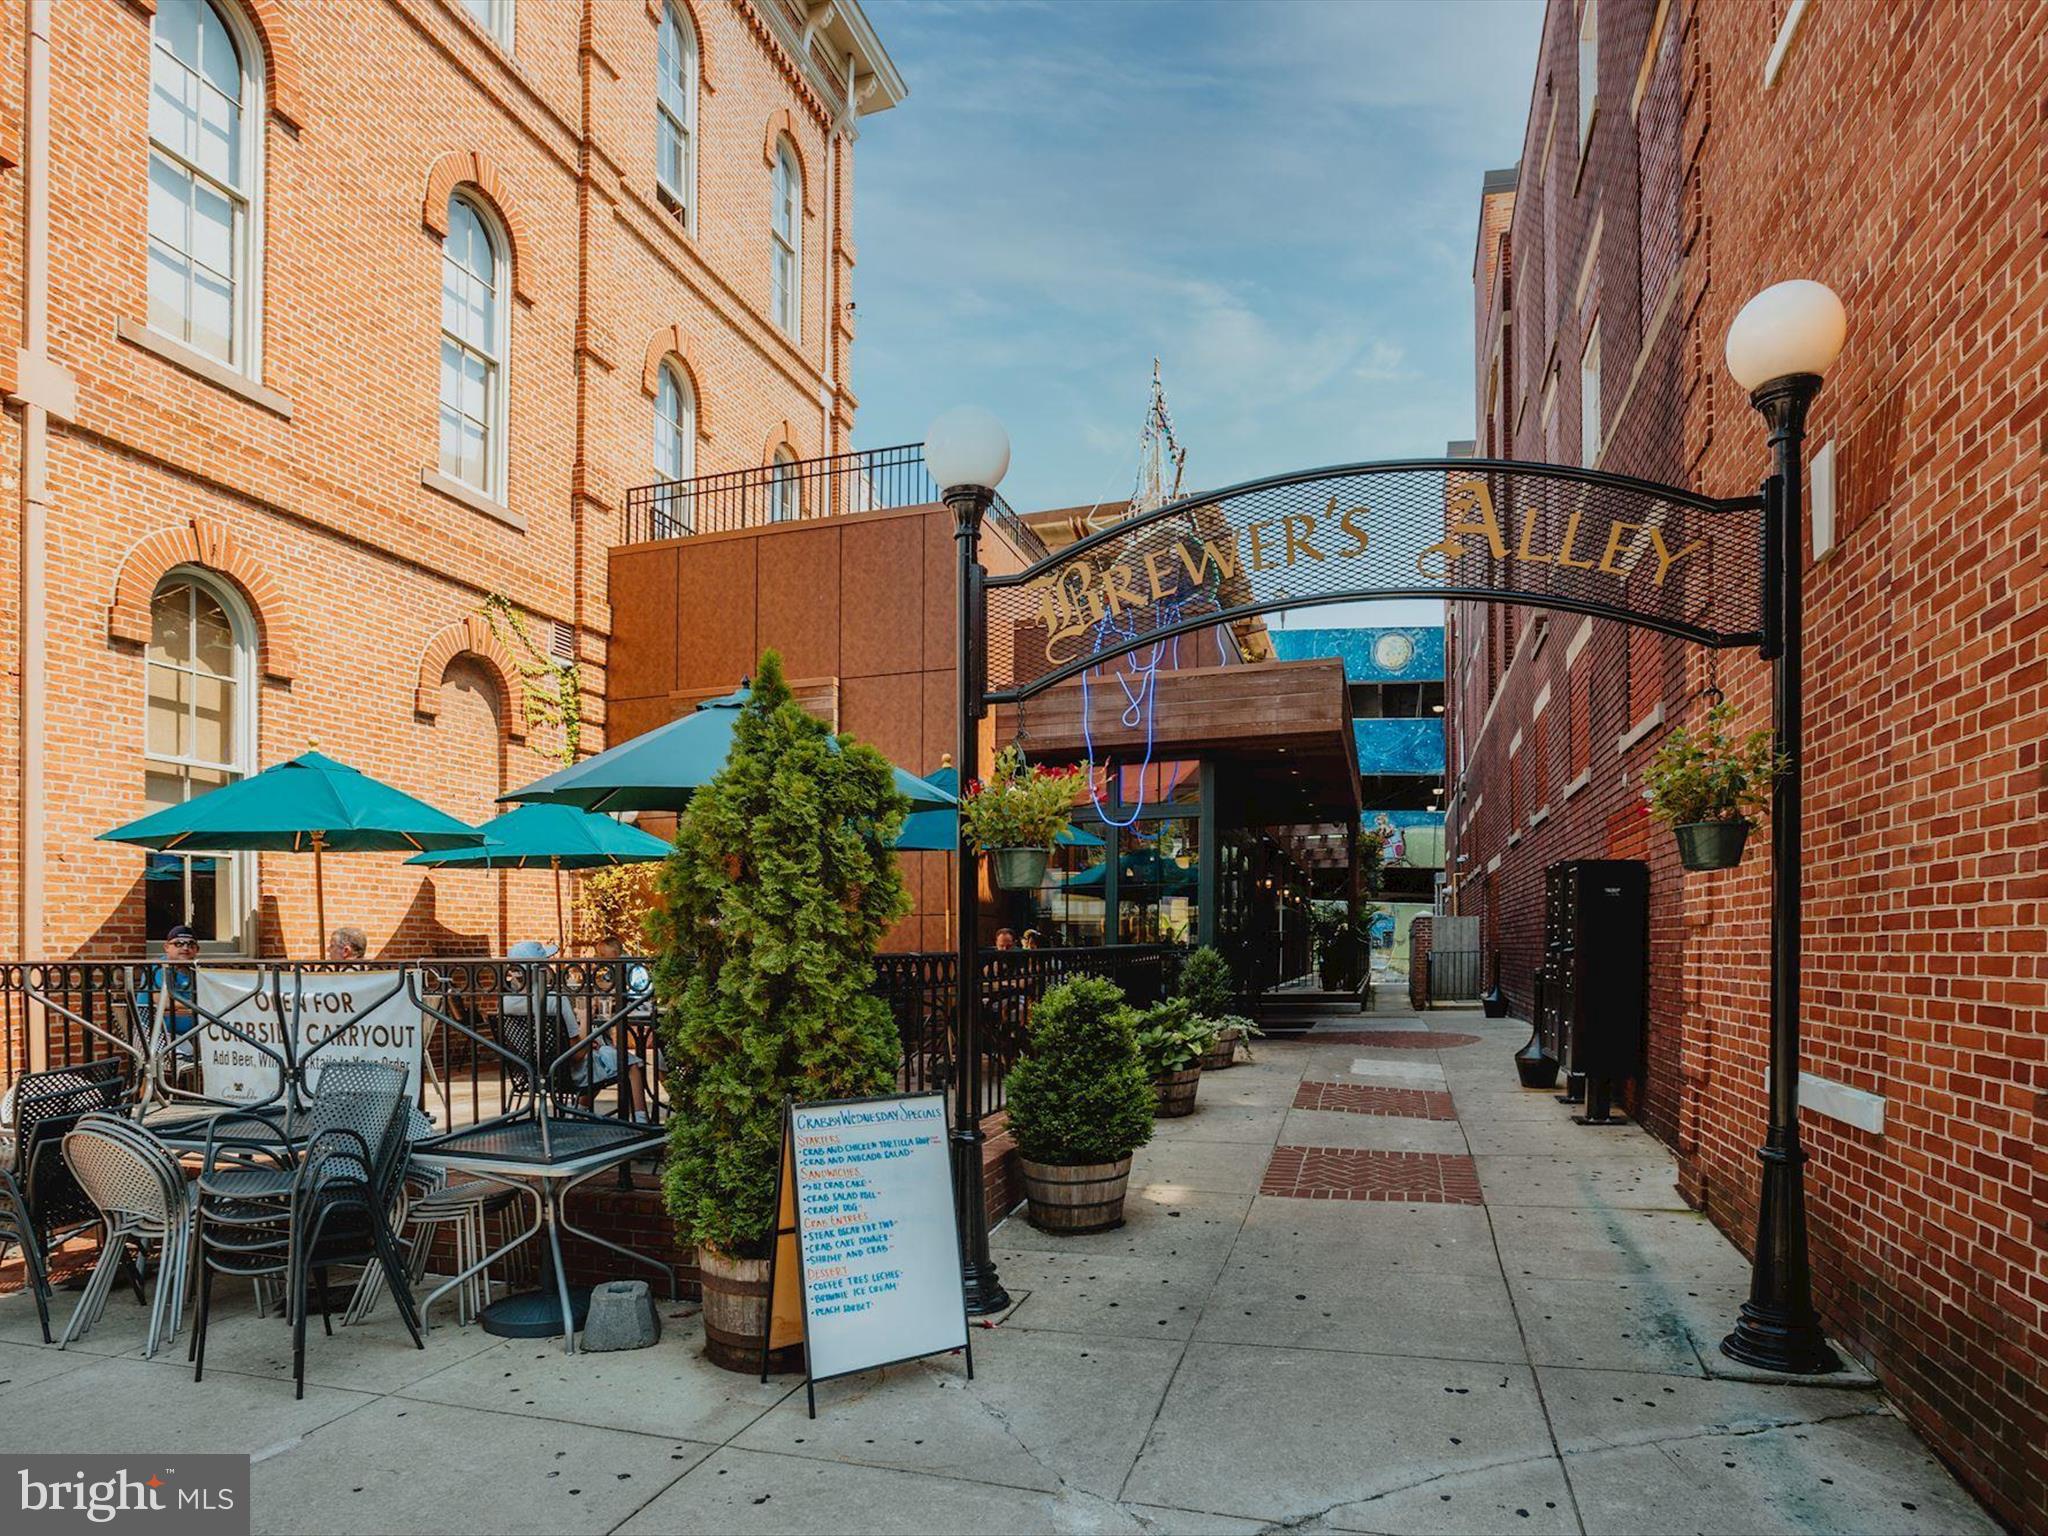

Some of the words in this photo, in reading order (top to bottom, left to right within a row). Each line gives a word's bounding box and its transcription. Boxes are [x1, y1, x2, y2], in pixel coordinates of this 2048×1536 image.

[314, 992, 355, 1013] FOR
[306, 1023, 415, 1048] CARRYOUT
[213, 1050, 229, 1066] Add
[232, 1051, 256, 1068] Beer,
[899, 1101, 942, 1121] SPECIALS
[803, 1148, 825, 1156] CRAB
[826, 1145, 844, 1154] AND
[803, 1158, 825, 1166] CRAB
[828, 1156, 844, 1165] AND
[884, 1148, 911, 1159] SALAD
[824, 1181, 845, 1189] CRAB
[807, 1194, 829, 1203] CRAB
[833, 1192, 858, 1201] SALAD
[808, 1230, 835, 1241] STEAK
[809, 1242, 833, 1254] CRAB
[835, 1238, 855, 1249] CAKE
[809, 1254, 842, 1265] SHRIMP
[846, 1249, 864, 1258] AND
[866, 1245, 888, 1254] CRAB
[813, 1279, 843, 1291] COFFEE
[848, 1274, 868, 1285] TRES
[872, 1270, 900, 1282] LECHES
[853, 1288, 865, 1297] ICE
[815, 1305, 840, 1316] PEACH
